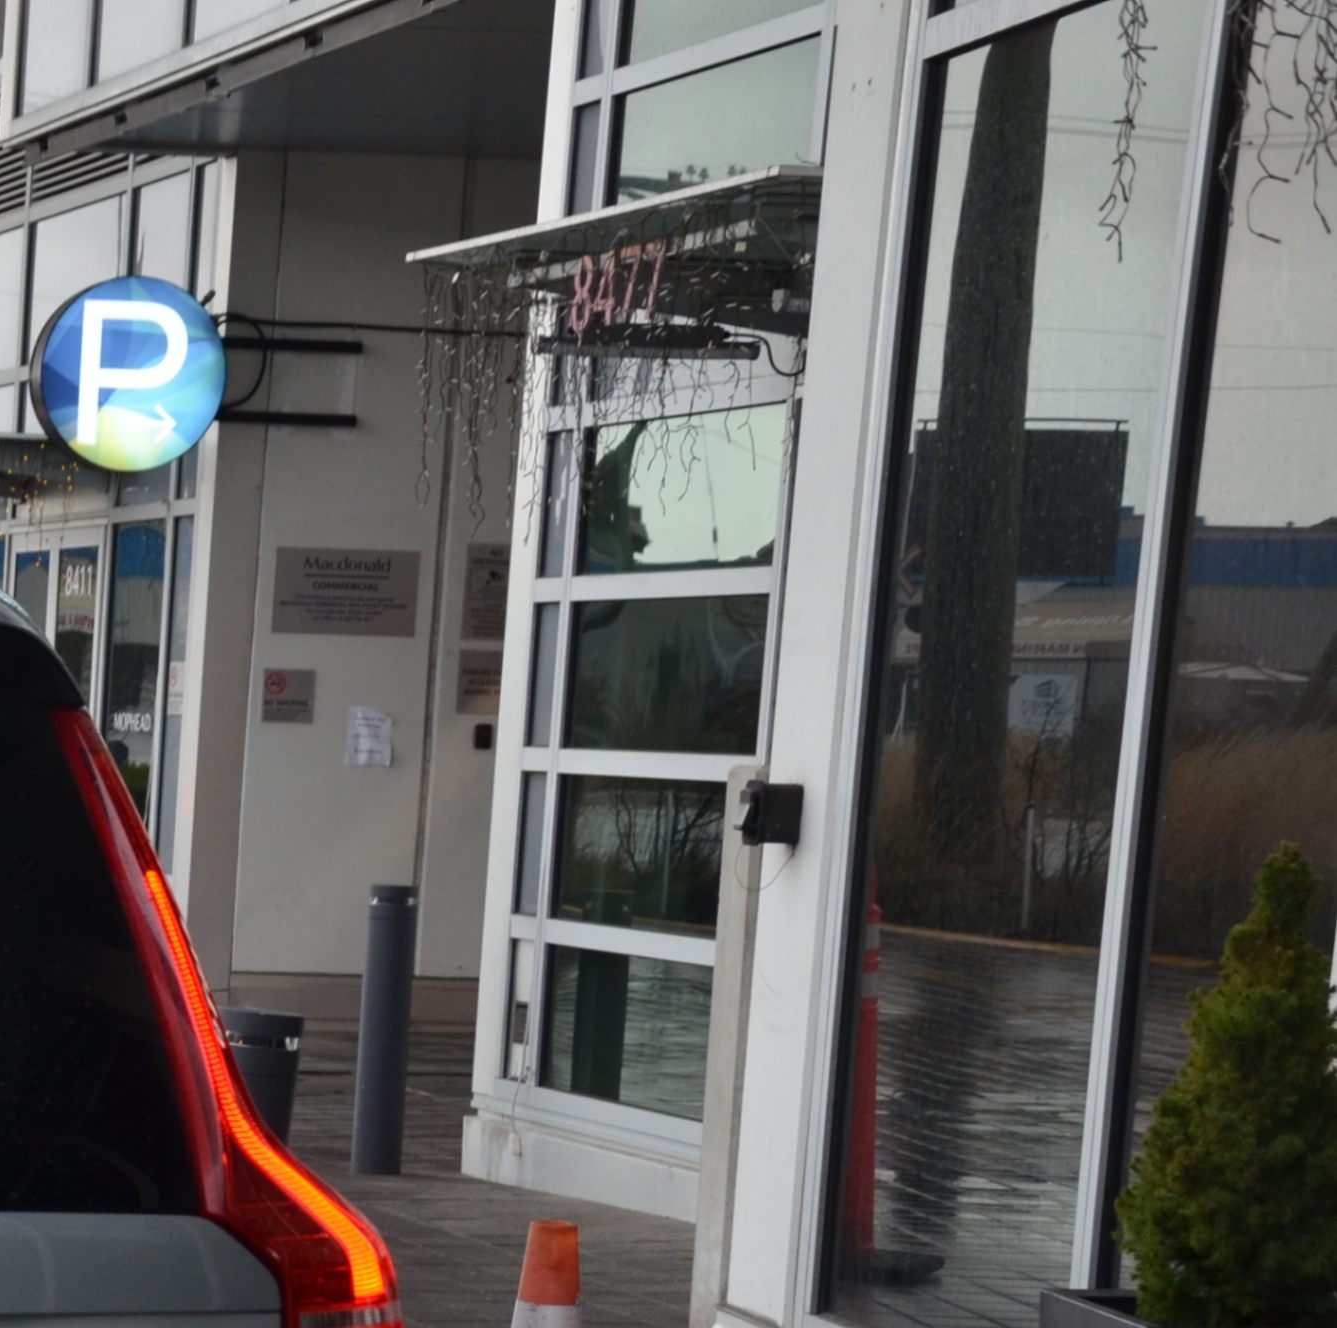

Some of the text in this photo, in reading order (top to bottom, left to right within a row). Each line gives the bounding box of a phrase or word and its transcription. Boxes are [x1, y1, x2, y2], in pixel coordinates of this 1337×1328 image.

[569, 239, 667, 332] 8477
[76, 298, 188, 446] P
[65, 564, 93, 596] 8411
[304, 556, 392, 573] Macdonald
[312, 580, 380, 592] COMMERCIAL
